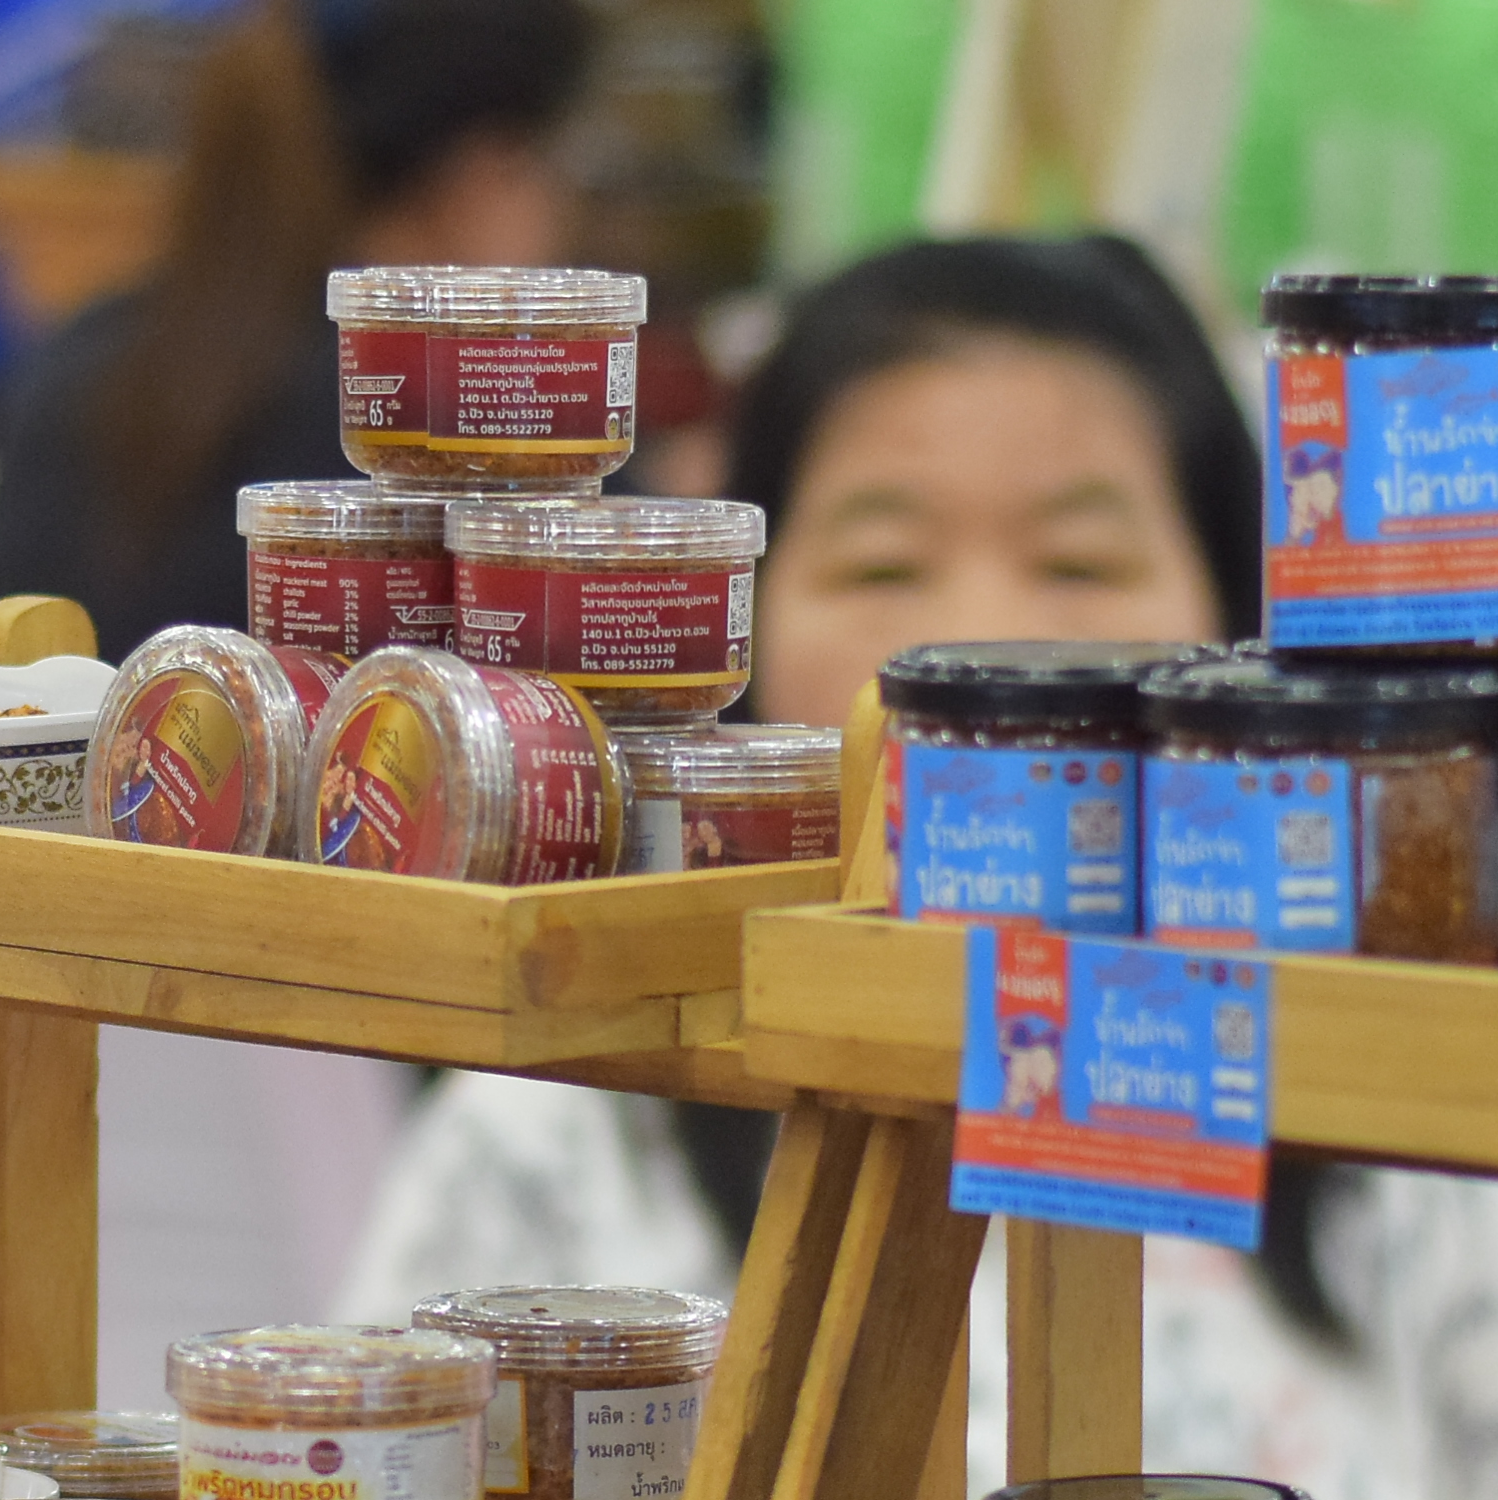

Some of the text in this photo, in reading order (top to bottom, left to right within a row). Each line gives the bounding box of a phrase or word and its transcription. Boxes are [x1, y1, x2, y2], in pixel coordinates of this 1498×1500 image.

[458, 346, 565, 358] ผลิตและจัดจำหน่ายโดย
[458, 375, 534, 391] จากปลาทูบ้านไร่
[459, 394, 479, 403] 140
[369, 400, 383, 426] 65
[487, 408, 518, 419] จ.น่าน
[521, 410, 553, 419] 55120
[458, 423, 551, 434] โทร. 089-5522779
[285, 558, 327, 569] Ingredients
[339, 579, 359, 588] 90%
[582, 580, 687, 593] ผลิตและจัดจำหน่ายโดย
[345, 601, 359, 610] 2%
[345, 612, 359, 622] 2%
[582, 609, 657, 626] จากปลาทูบ้านไร่
[582, 629, 601, 639] 140
[488, 636, 501, 662] 65
[610, 643, 642, 654] จ.น่าน
[644, 644, 676, 654] 55120
[582, 658, 674, 670] โทร. 089-5522779
[160, 749, 197, 804] น้ำพริกปลาทู
[588, 1405, 623, 1424] ผลิต
[588, 1442, 655, 1461] หมดอายุ
